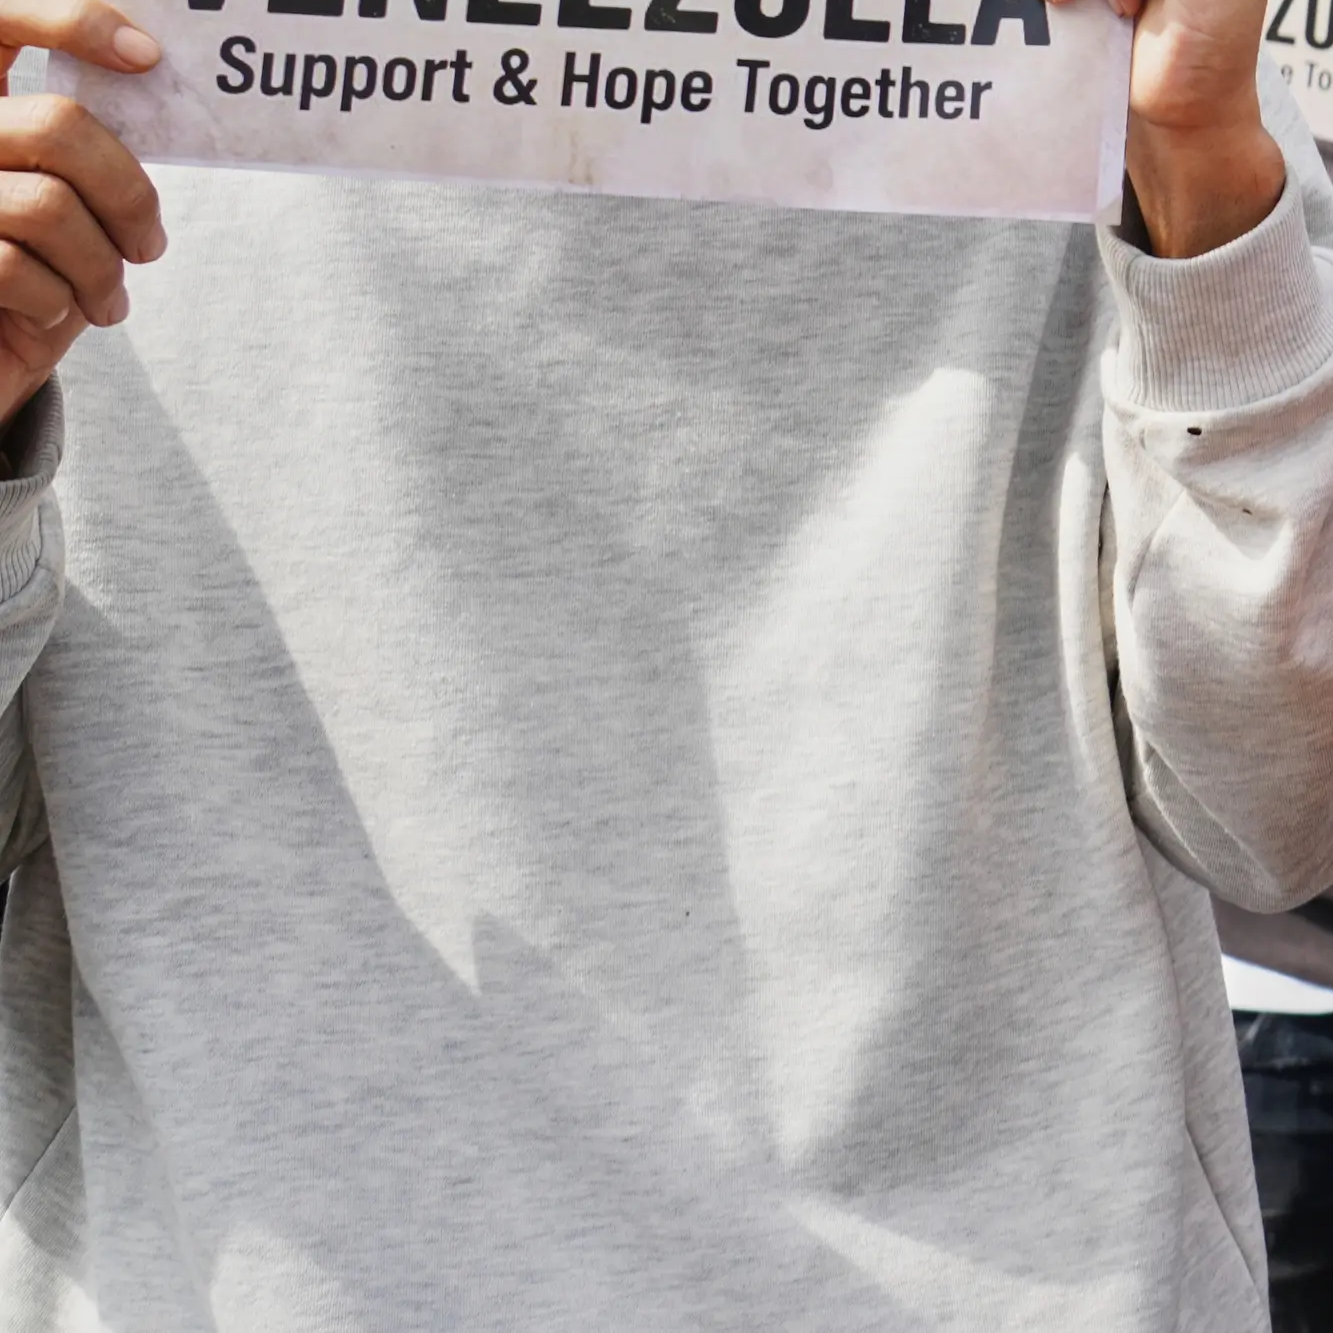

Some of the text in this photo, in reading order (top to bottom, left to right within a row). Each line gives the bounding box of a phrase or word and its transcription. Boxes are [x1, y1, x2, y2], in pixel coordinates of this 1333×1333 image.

[215, 35, 993, 130] Support & Hope Together
